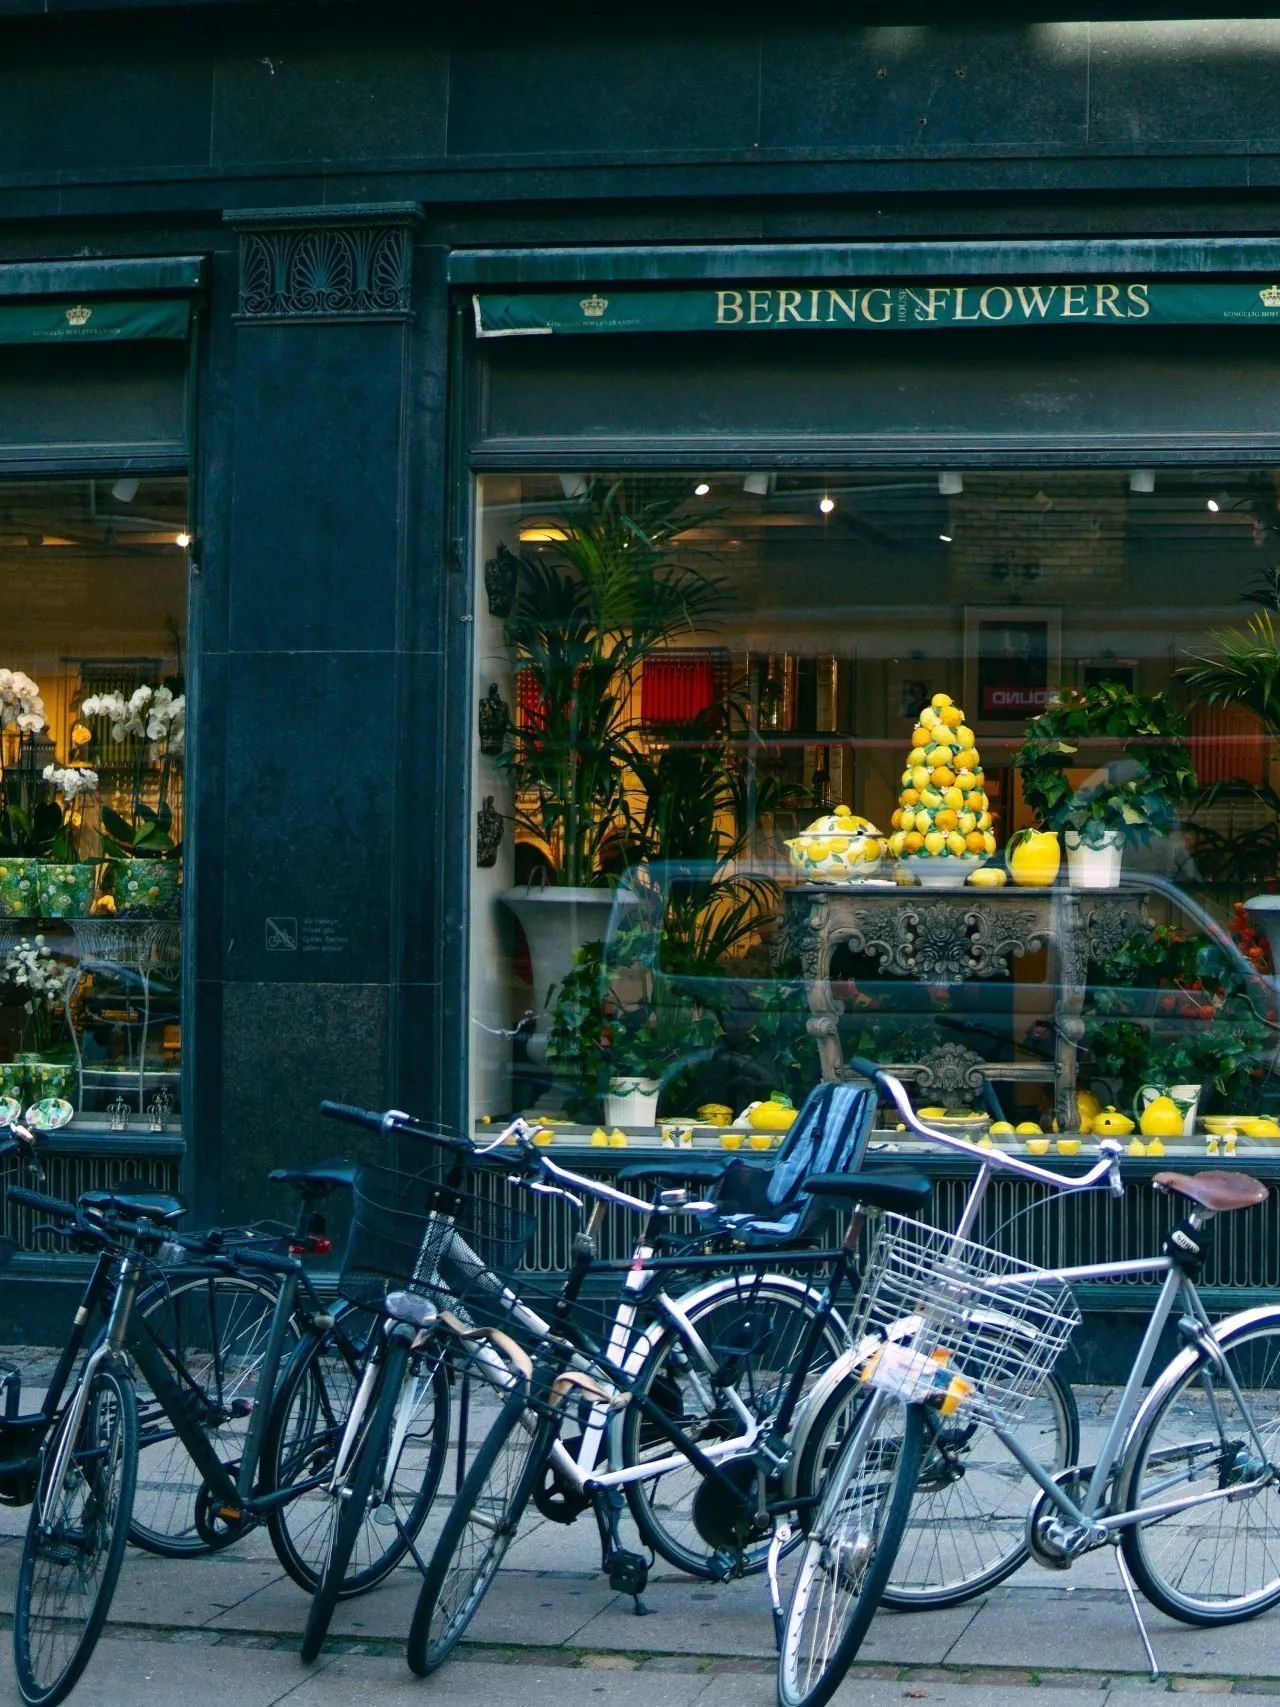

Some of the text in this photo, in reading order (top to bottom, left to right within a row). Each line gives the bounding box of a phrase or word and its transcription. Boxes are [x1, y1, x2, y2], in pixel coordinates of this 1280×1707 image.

[714, 288, 895, 325] BERING
[897, 288, 907, 322] HOUSE
[925, 283, 1151, 321] FLOWERS
